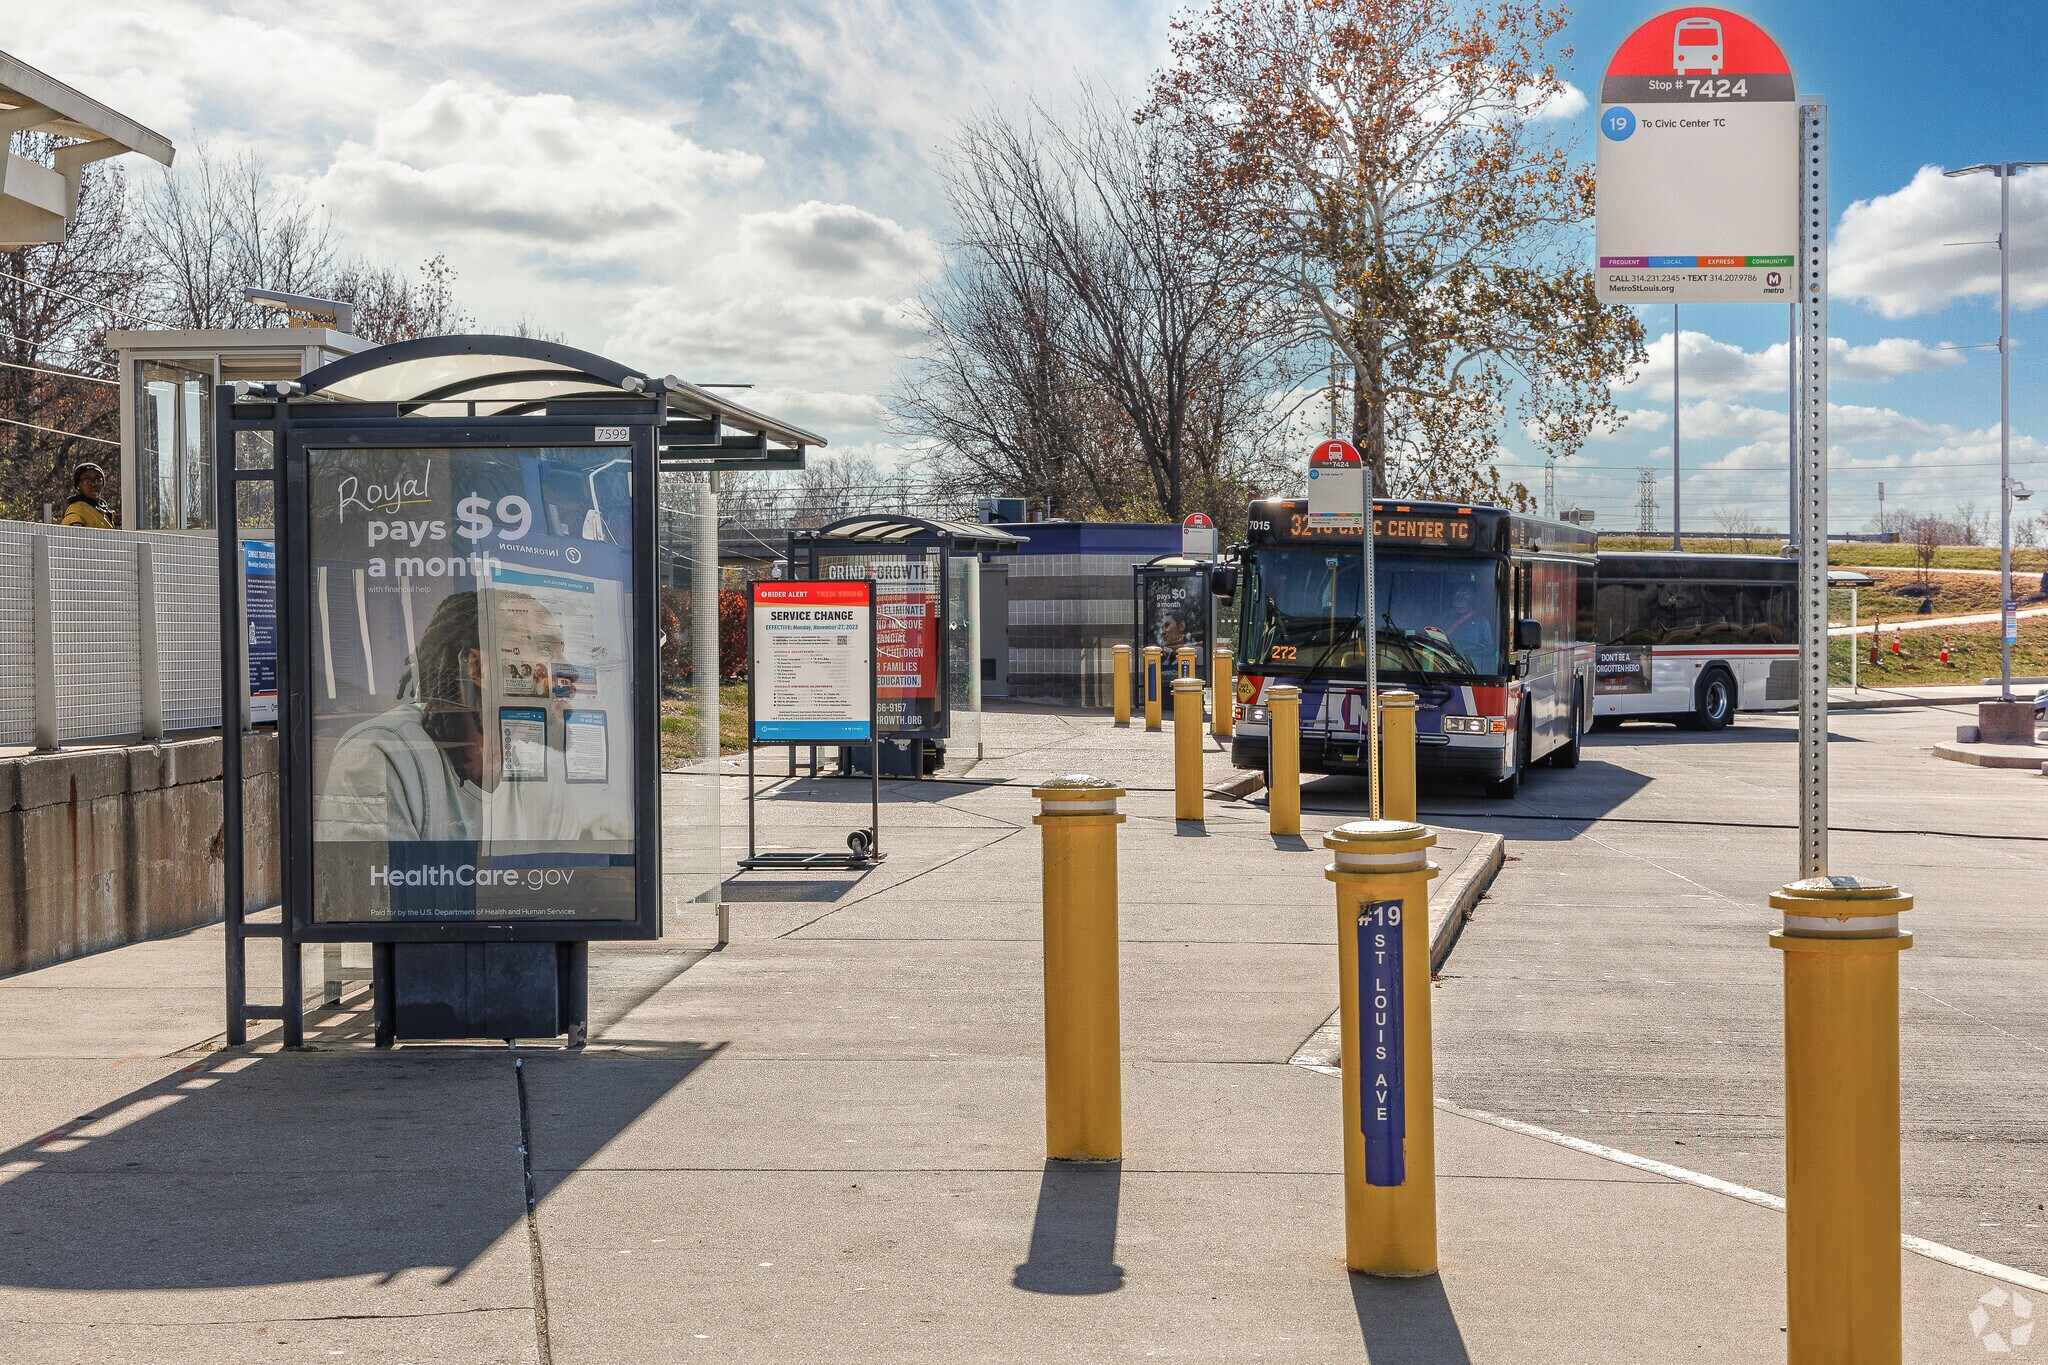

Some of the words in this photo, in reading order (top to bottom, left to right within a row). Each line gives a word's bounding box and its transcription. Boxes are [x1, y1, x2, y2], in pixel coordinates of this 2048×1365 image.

[1648, 80, 1672, 91] Stop
[1686, 79, 1748, 98] 7424
[1610, 117, 1627, 131] 19
[1642, 120, 1652, 128] To
[1655, 119, 1677, 128] Civic
[1680, 119, 1710, 128] Center
[1713, 118, 1726, 127] TC
[1631, 274, 1680, 282] 314.231.2345
[1687, 274, 1708, 282] TEXT
[1710, 274, 1757, 282] 314.207.9786
[1609, 284, 1675, 293] MetroStLouis.org
[597, 429, 627, 440] 7599
[338, 458, 431, 524] Royal
[368, 520, 447, 548] pays
[456, 492, 532, 544] $9
[1249, 520, 1270, 531] 7015
[1291, 514, 1312, 536] 32
[1388, 521, 1444, 538] CENTER
[1450, 523, 1468, 539] TC
[368, 557, 386, 577] a
[395, 550, 502, 577] month
[828, 565, 866, 580] GRIND
[877, 565, 928, 579] GROWTH
[368, 585, 384, 593] with
[384, 585, 414, 593] financial
[416, 585, 432, 594] help
[1172, 588, 1186, 600] $0
[771, 611, 811, 620] SERVICE
[814, 611, 854, 620] CHANGE
[884, 606, 924, 615] ELIMINATE
[889, 620, 923, 629] IMPROVE
[886, 648, 923, 657] CHILDREN
[1272, 645, 1297, 660] 272
[883, 662, 917, 671] FAMILIES
[1625, 664, 1640, 672] HERO
[877, 676, 920, 685] EDUCATION.
[877, 703, 907, 712] 66-9157
[370, 864, 574, 891] HealthCare.gov
[398, 909, 406, 917] by
[434, 909, 475, 917] Department
[1358, 906, 1401, 926] #19
[1374, 934, 1386, 964] ST
[1374, 978, 1387, 1060] LOUIS
[1374, 1073, 1388, 1121] AVE
